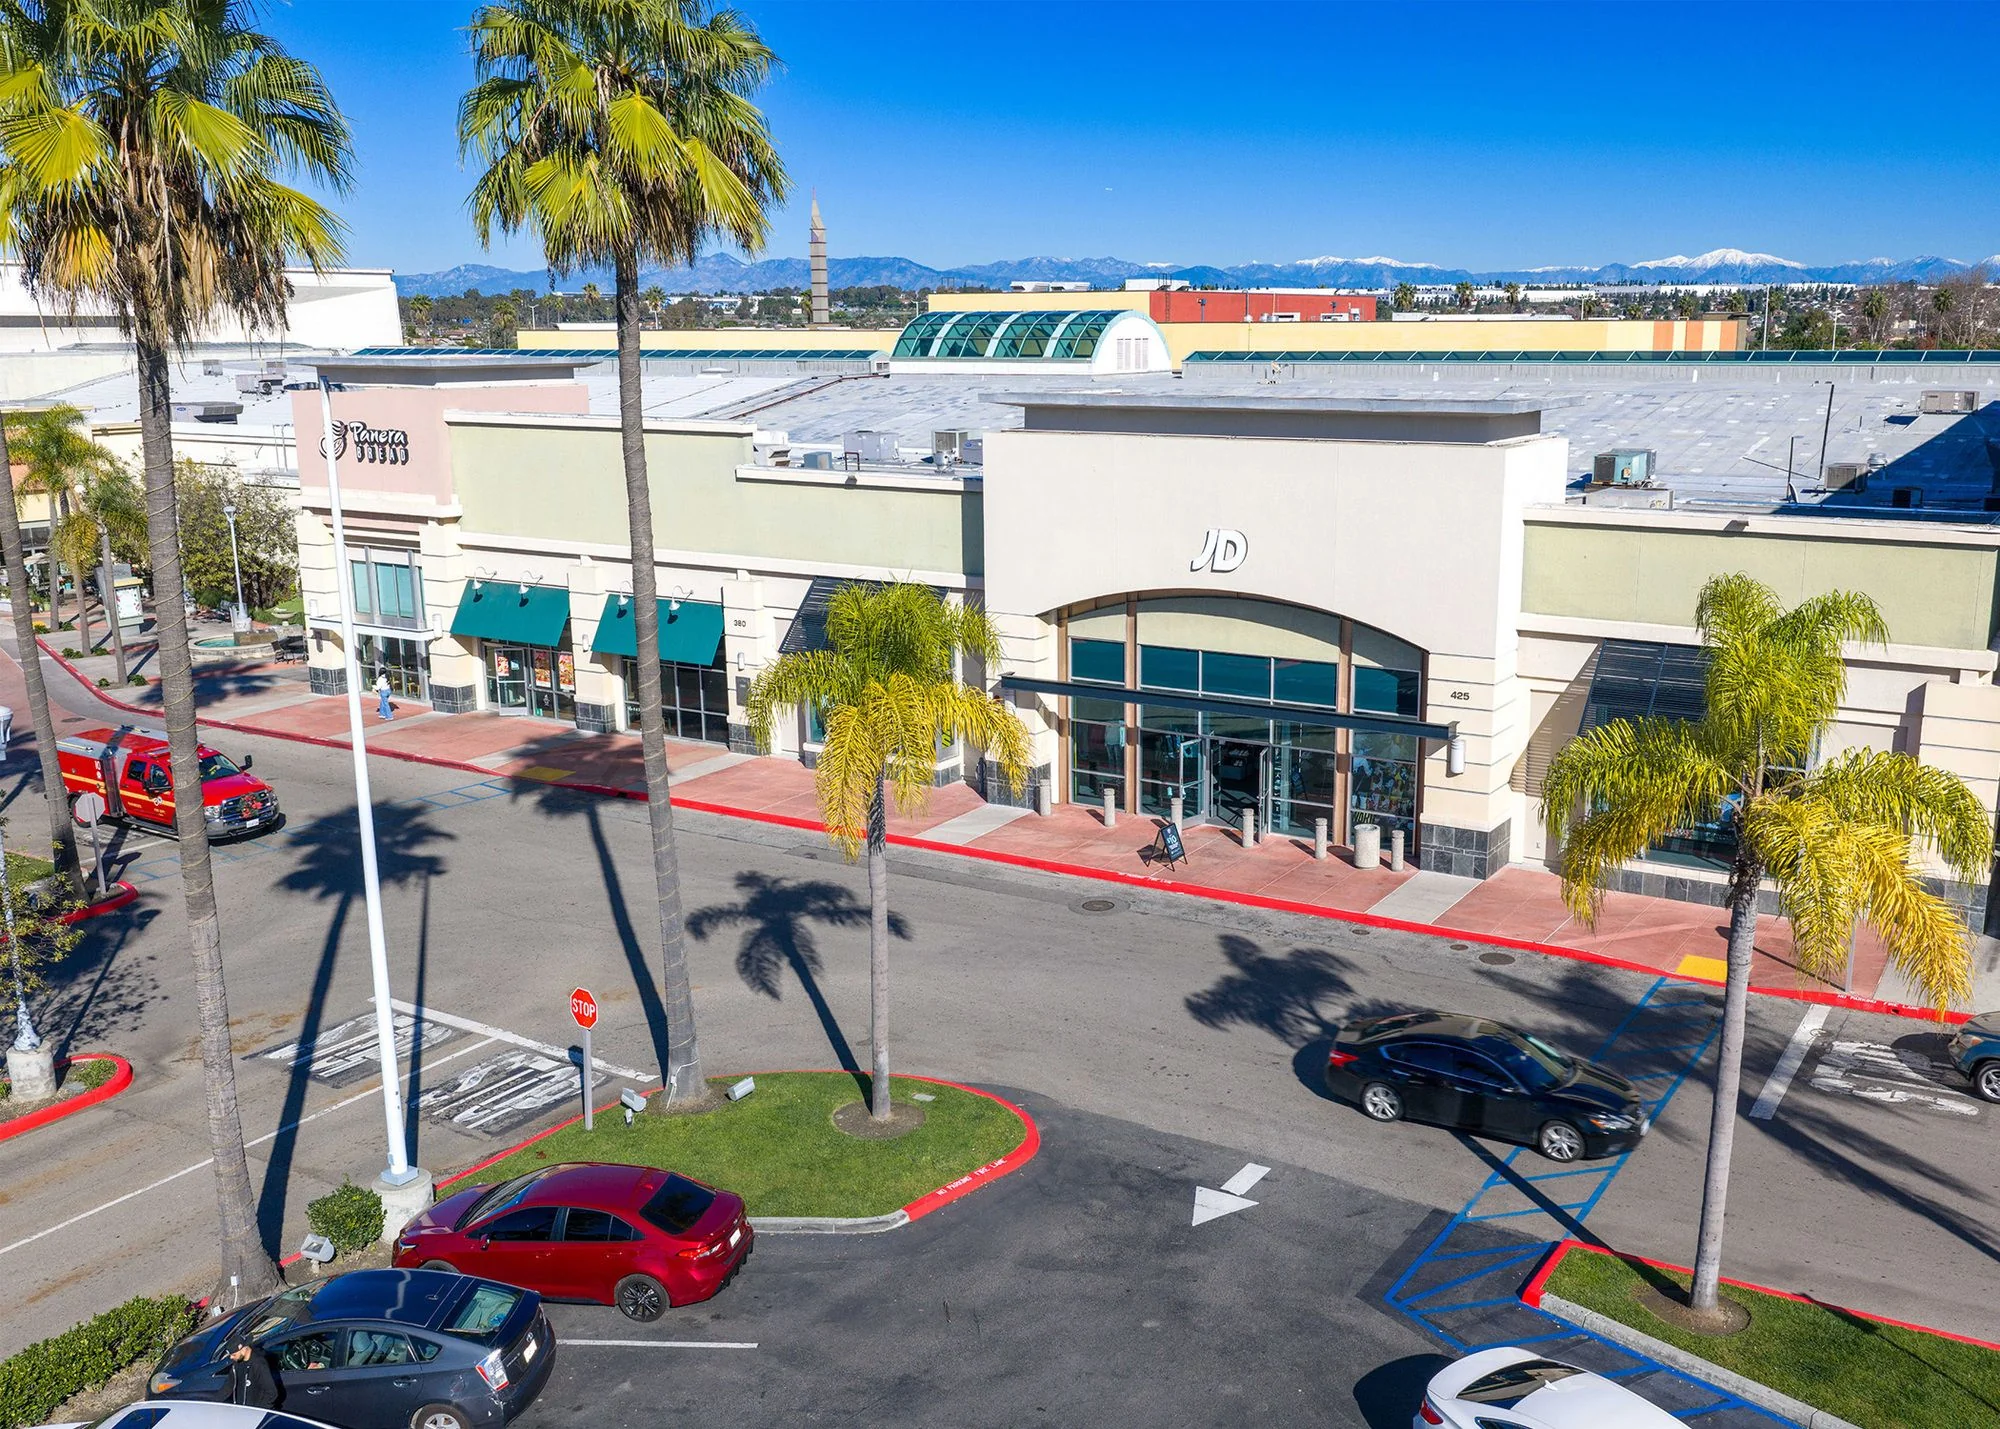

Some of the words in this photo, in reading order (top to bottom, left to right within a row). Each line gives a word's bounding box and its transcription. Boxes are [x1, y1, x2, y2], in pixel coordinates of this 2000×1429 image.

[349, 421, 408, 447] Panera
[356, 445, 409, 465] BREAD
[1190, 528, 1249, 573] JD
[733, 619, 747, 628] 380
[1450, 690, 1470, 701] 425
[572, 998, 596, 1018] STOP
